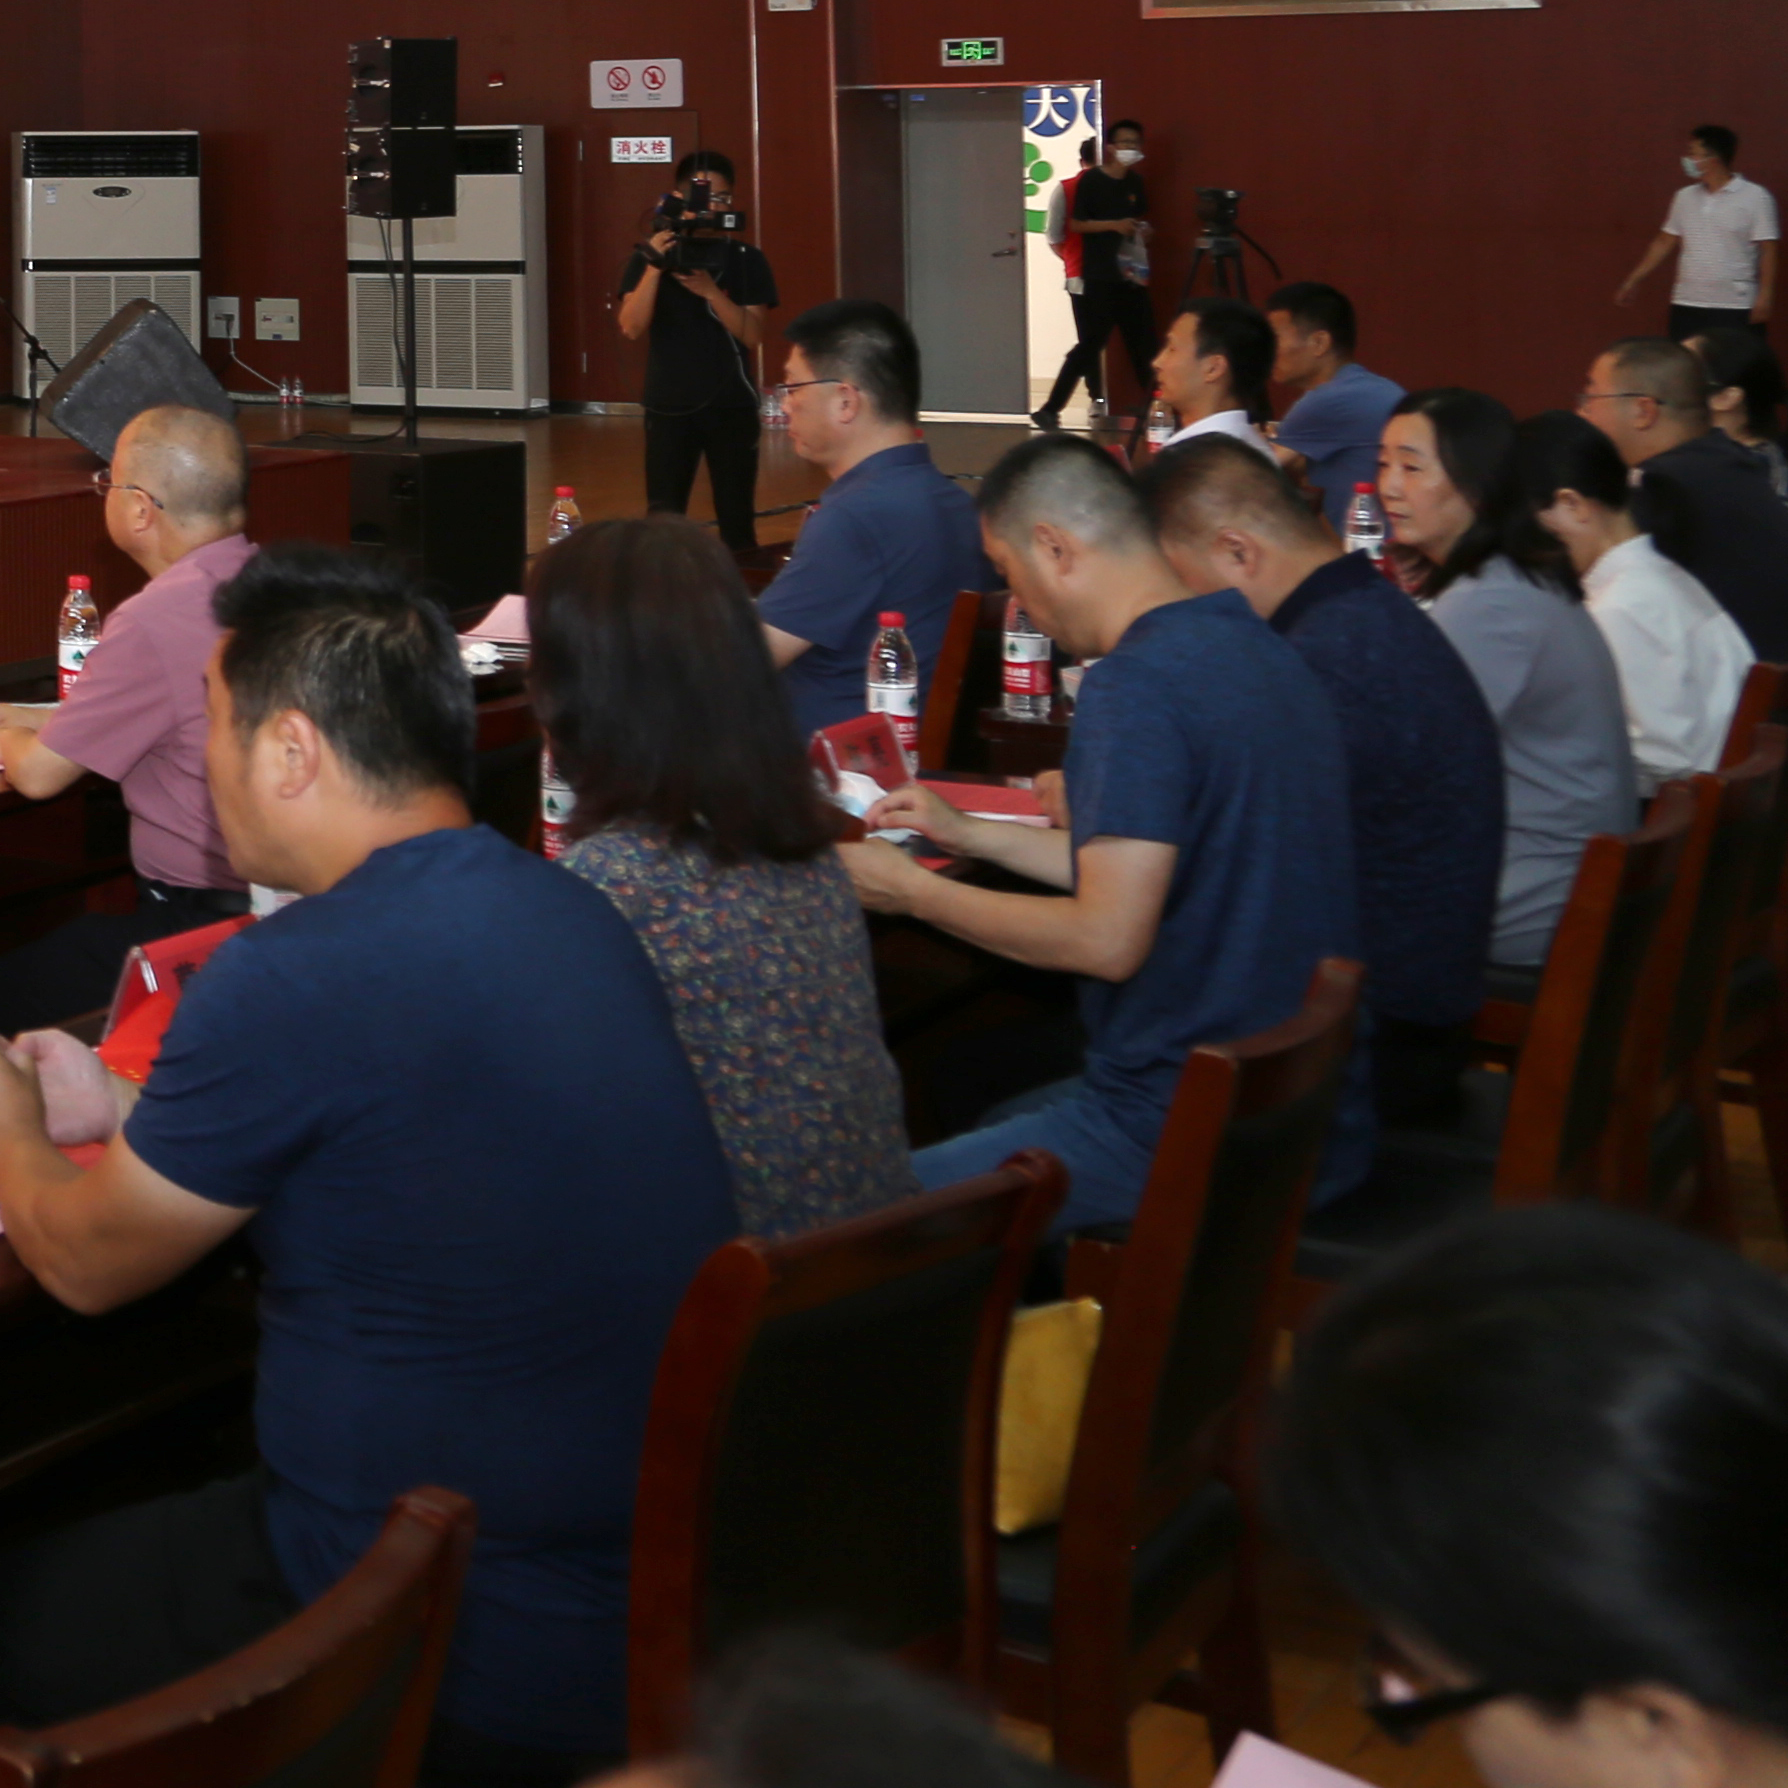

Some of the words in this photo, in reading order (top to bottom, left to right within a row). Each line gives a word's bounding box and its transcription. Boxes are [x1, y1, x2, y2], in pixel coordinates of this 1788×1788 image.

[1025, 87, 1071, 130] 大
[616, 140, 667, 155] 消火栓
